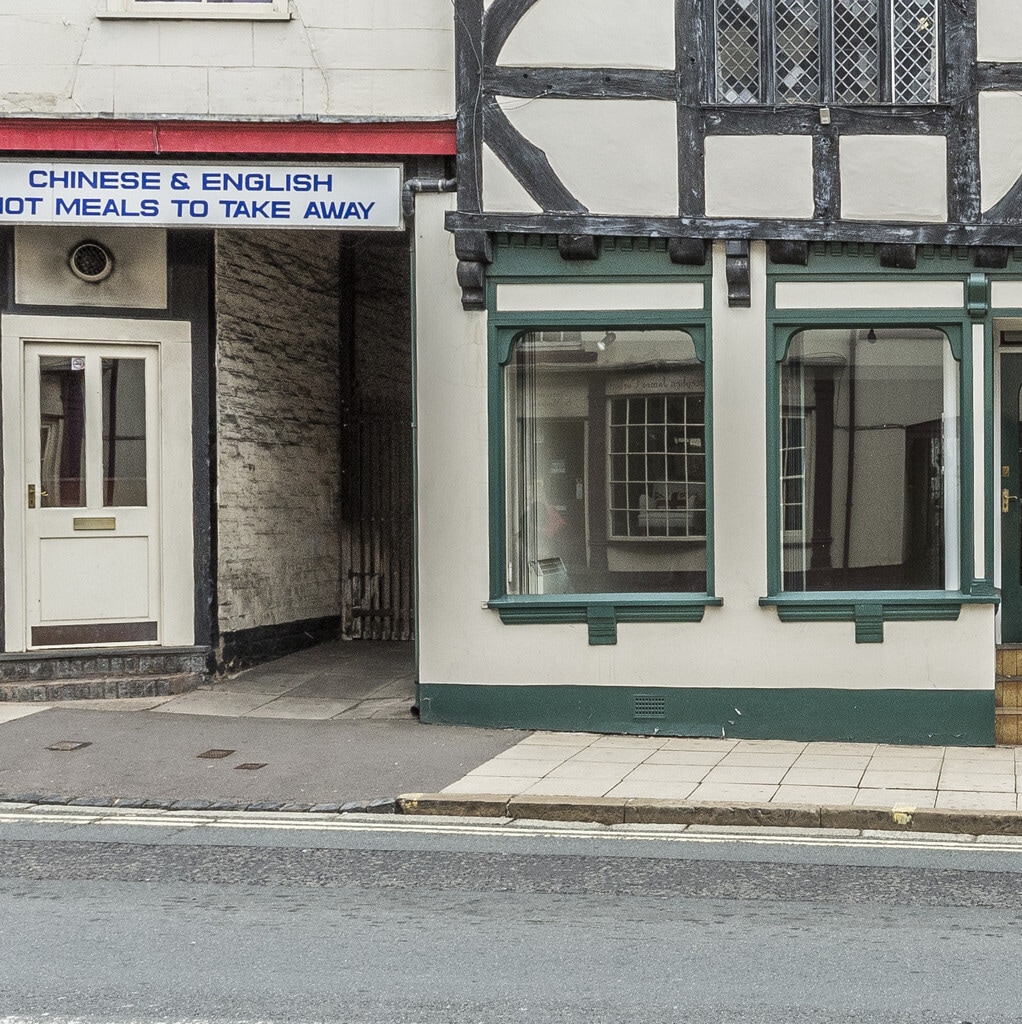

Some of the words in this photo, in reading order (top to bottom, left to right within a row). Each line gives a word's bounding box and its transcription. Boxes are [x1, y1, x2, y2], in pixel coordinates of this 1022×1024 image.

[29, 170, 161, 190] CHINESE
[170, 172, 190, 191] &
[201, 173, 333, 192] ENGLISH
[55, 198, 159, 217] MEALS
[171, 199, 209, 218] TO
[220, 200, 290, 219] TAKE
[304, 202, 374, 220] AWAY
